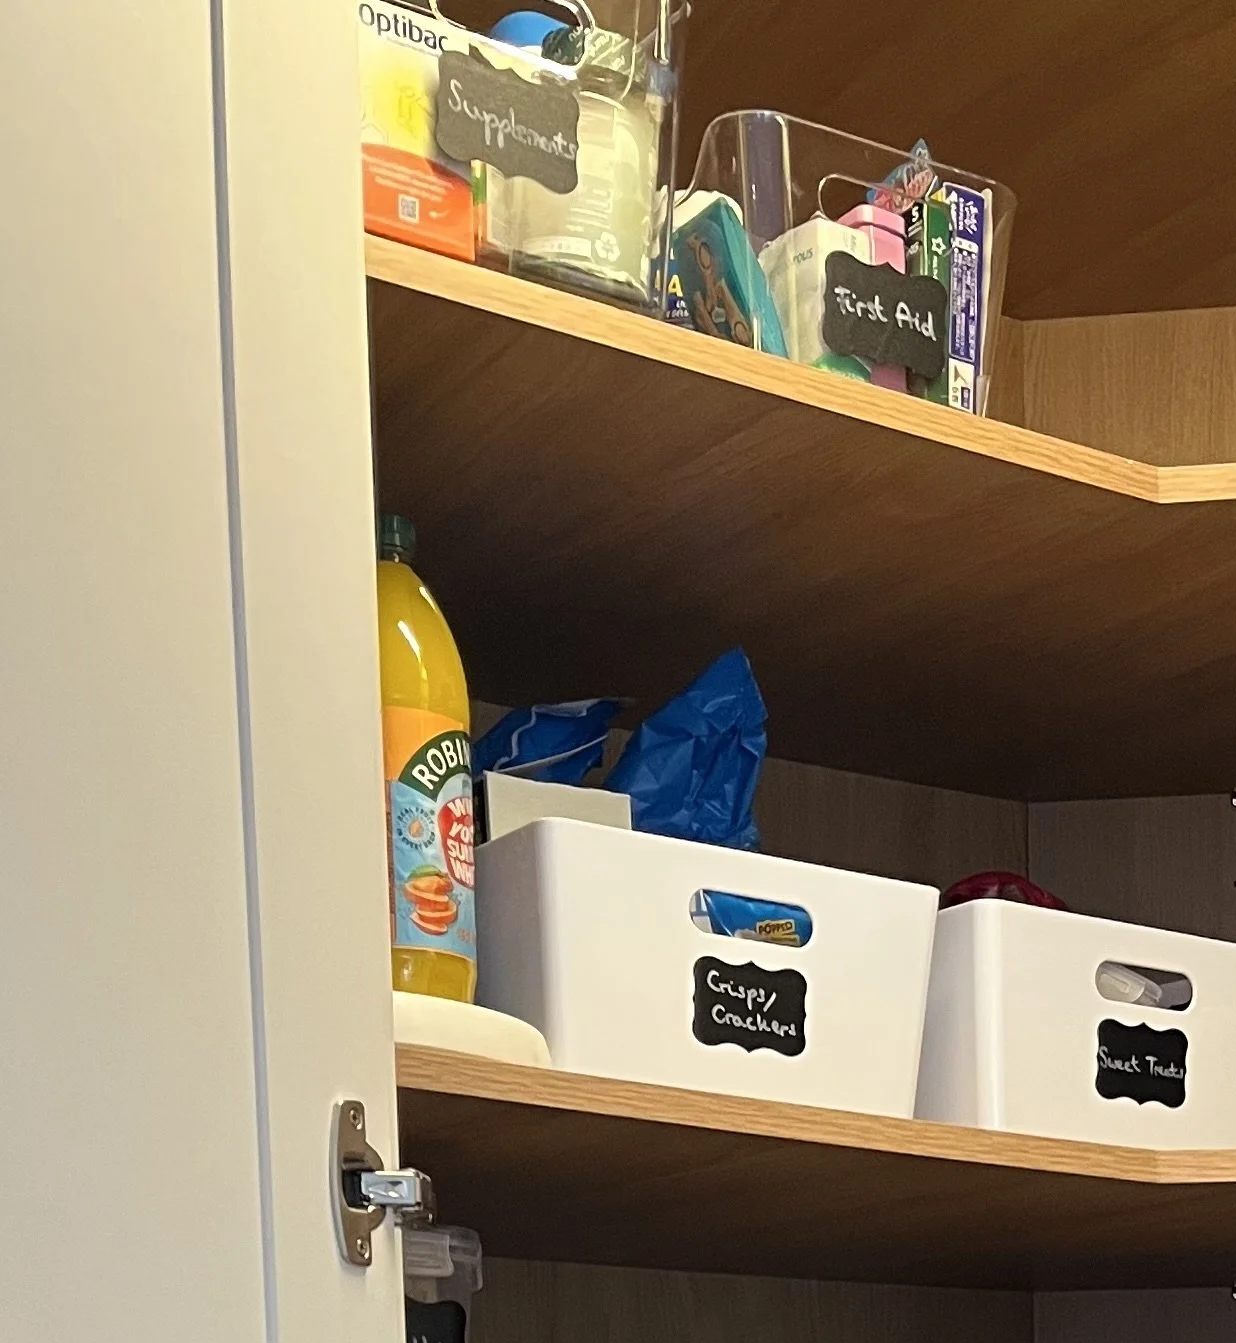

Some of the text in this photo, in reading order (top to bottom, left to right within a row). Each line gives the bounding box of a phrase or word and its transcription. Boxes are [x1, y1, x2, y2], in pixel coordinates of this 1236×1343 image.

[358, 3, 449, 51] Optibac
[448, 79, 576, 161] Supplements
[834, 285, 937, 342] First Aid
[711, 1004, 796, 1037] Crackers
[1099, 1045, 1141, 1073] Sweet
